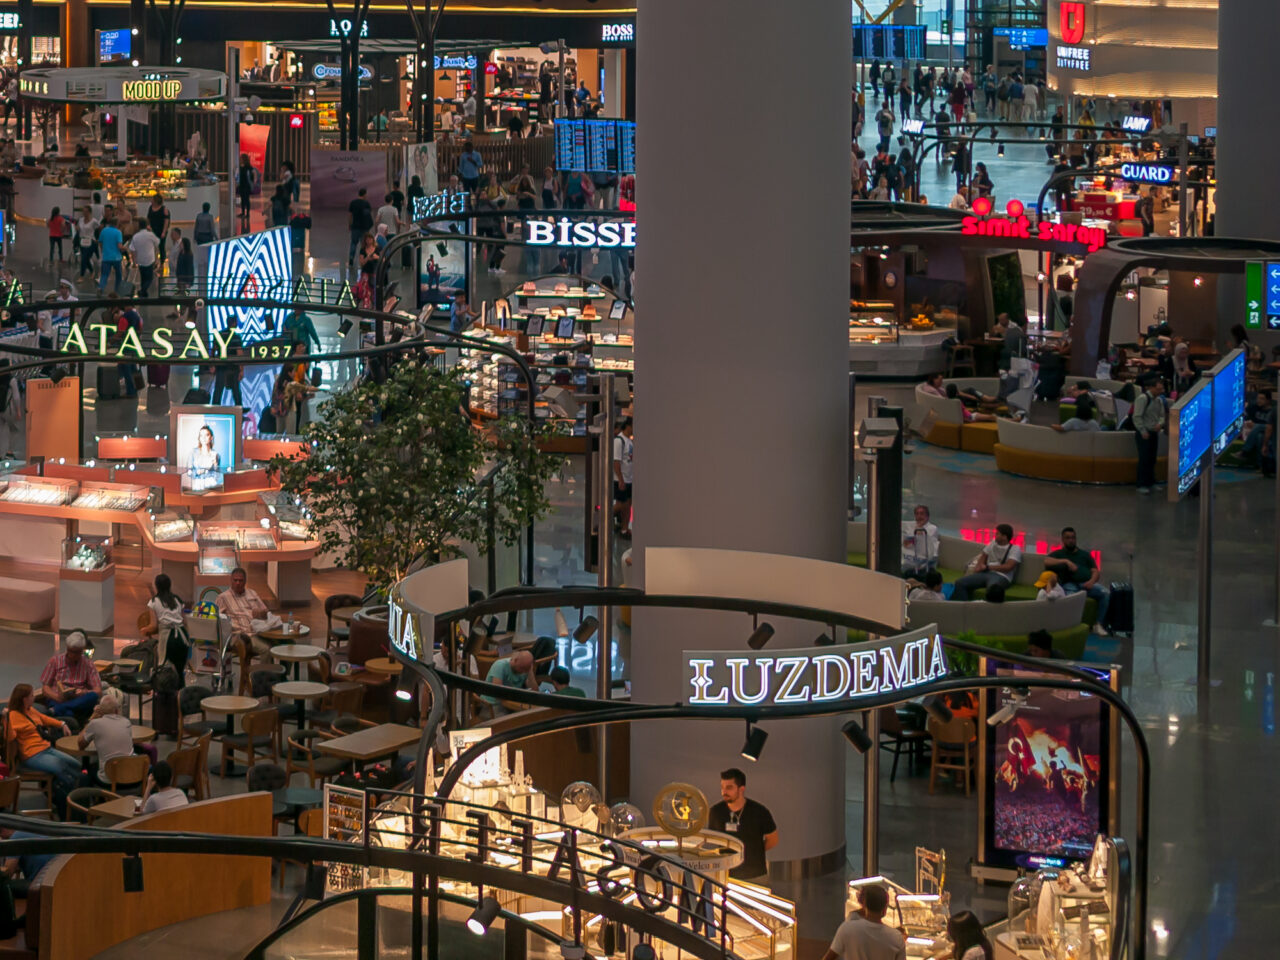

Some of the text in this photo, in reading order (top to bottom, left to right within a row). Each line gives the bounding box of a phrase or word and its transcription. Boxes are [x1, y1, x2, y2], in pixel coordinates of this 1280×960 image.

[602, 23, 633, 37] BOSS
[1057, 46, 1090, 60] UNIFREE
[123, 80, 182, 100] MOOD UP
[1122, 115, 1151, 132] LAMY
[1121, 163, 1171, 183] GUARD
[60, 322, 293, 359] ATASAY 1937
[689, 633, 947, 705] LUZDEMIA
